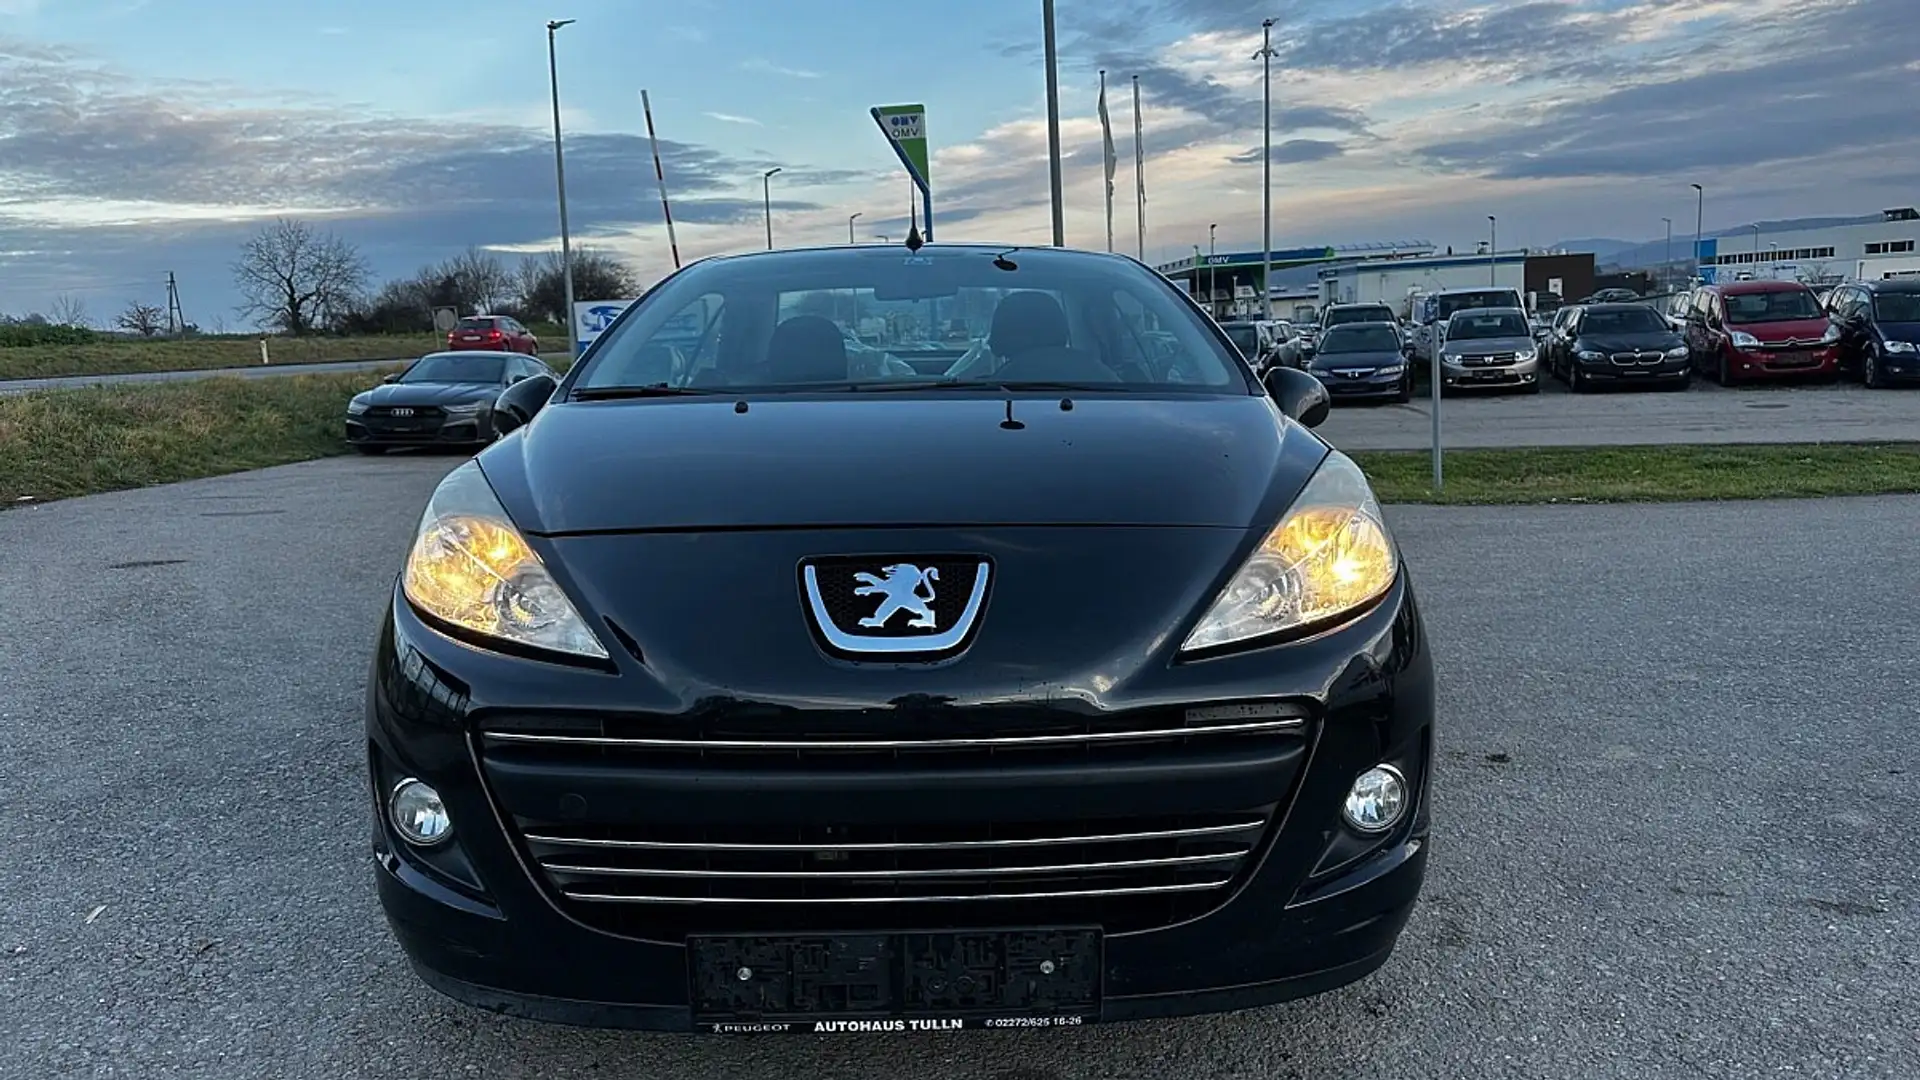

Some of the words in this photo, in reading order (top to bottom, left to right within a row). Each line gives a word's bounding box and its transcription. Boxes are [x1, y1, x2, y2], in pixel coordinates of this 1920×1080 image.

[891, 127, 919, 137] OMV
[1208, 256, 1229, 264] OMV
[724, 1023, 791, 1032] PEUGEOT
[814, 1020, 905, 1032] AUTOHAUS
[909, 1018, 963, 1030] TULLN
